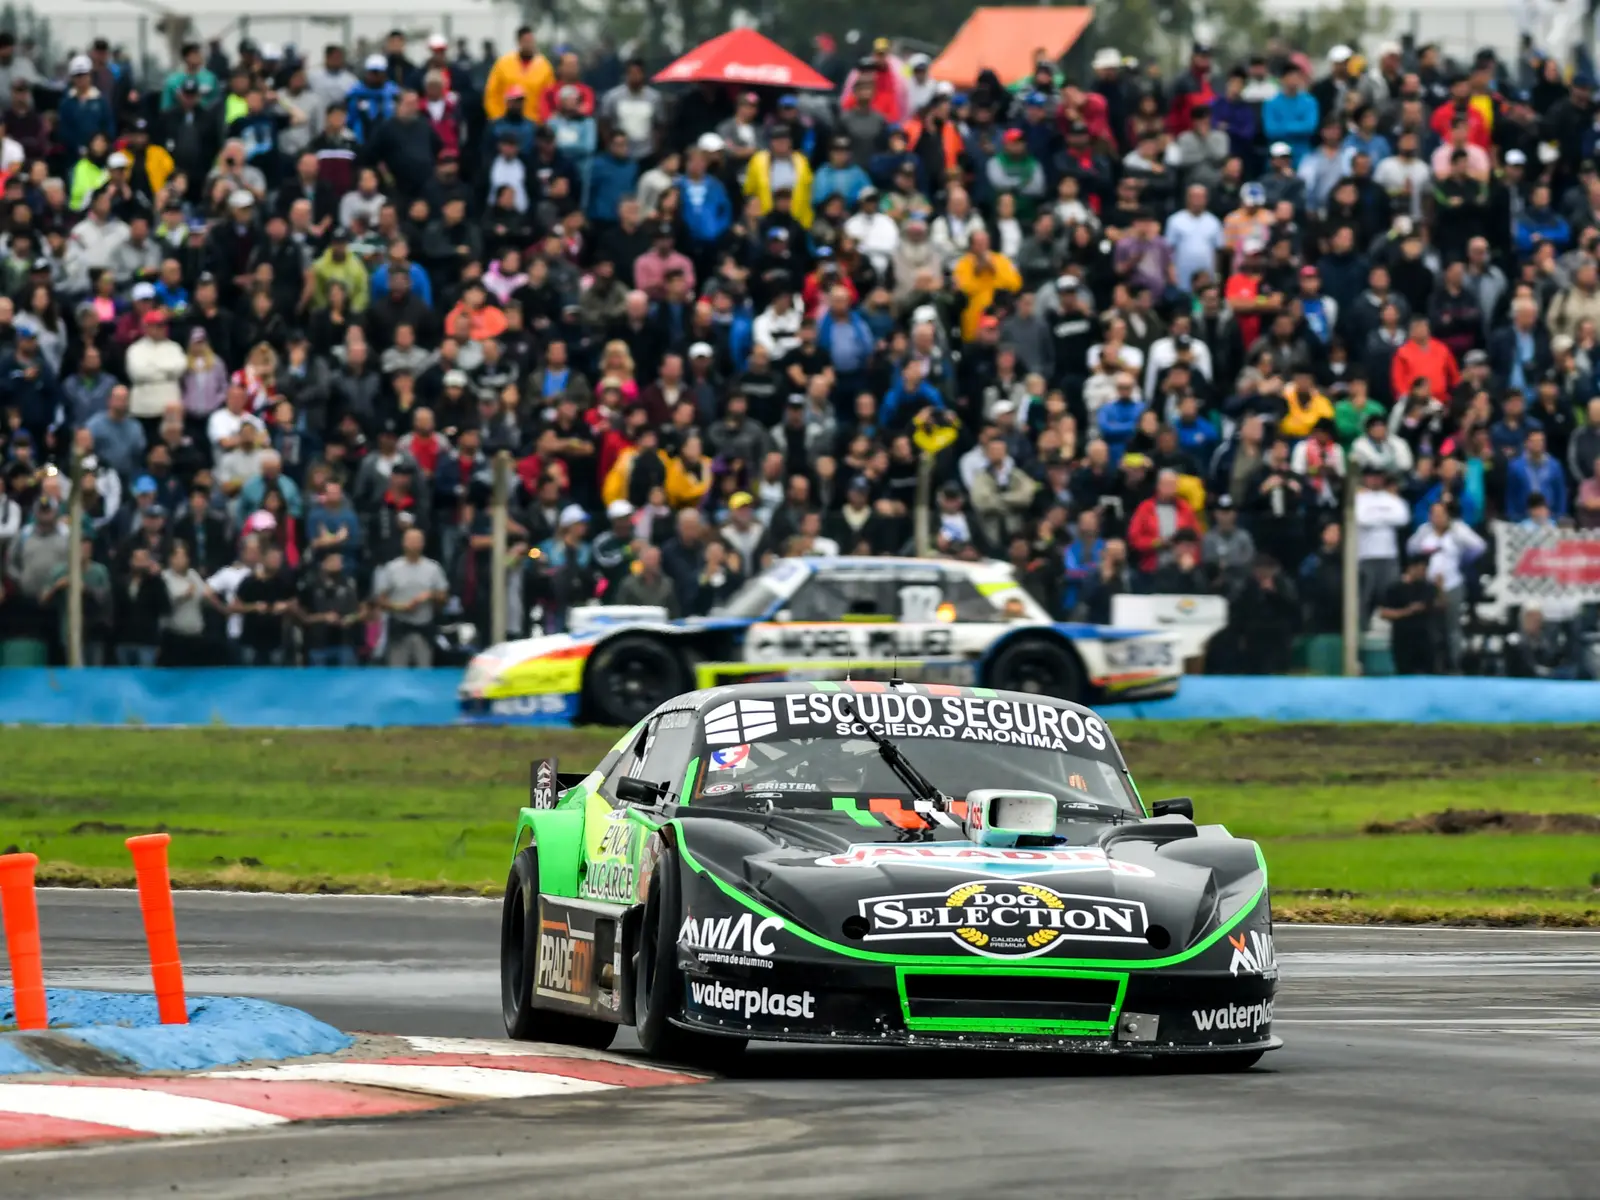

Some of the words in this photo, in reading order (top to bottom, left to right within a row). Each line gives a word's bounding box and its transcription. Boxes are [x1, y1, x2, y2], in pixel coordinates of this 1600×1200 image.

[785, 693, 932, 725] ESCUDO
[941, 696, 1107, 751] SEGUROS
[836, 722, 956, 739] SOCIEDAD
[961, 727, 1068, 751] ANONIMA
[756, 782, 817, 790] CRISTEM
[974, 893, 1040, 907] DOG
[873, 900, 1135, 932] SELECTION
[677, 912, 786, 956] AMAC
[730, 954, 739, 964] de
[739, 956, 774, 969] aluminio
[691, 980, 815, 1019] waterplast
